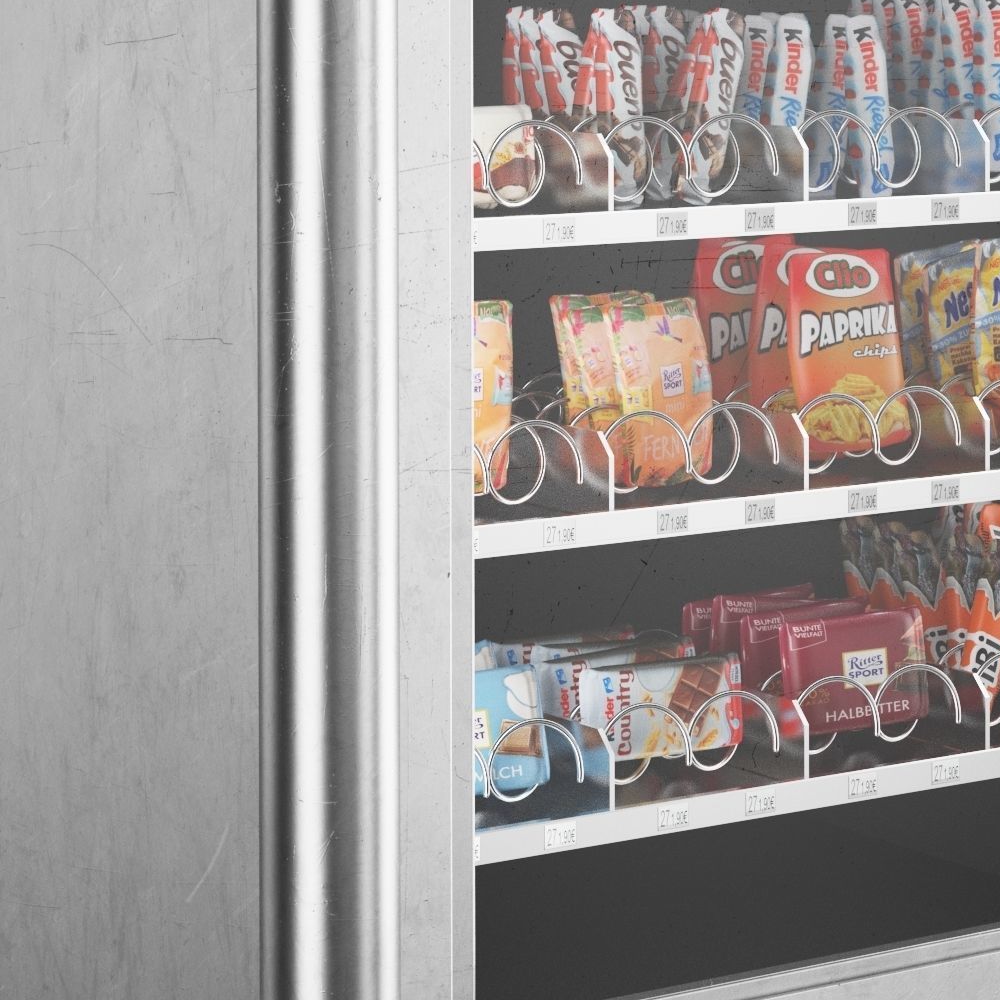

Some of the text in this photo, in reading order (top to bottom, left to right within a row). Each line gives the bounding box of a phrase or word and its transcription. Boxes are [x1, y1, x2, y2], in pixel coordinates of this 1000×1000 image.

[850, 206, 859, 223] 27
[934, 202, 942, 218] 27
[660, 217, 669, 234] 27
[748, 212, 756, 229] 27
[814, 259, 871, 290] Clio
[801, 304, 897, 356] PAPRIKA
[853, 344, 897, 358] chips
[663, 380, 682, 391] SPORT
[851, 493, 859, 509] 27
[748, 504, 757, 521] 27
[660, 514, 670, 530] 27
[547, 526, 556, 543] 27
[726, 600, 753, 609] BUNTE
[753, 617, 782, 626] BUNTE
[793, 623, 822, 633] BUNTE
[795, 630, 823, 639] VIELFALT
[848, 654, 883, 670] Ritter
[849, 667, 885, 679] SPORT
[851, 779, 860, 795] 27
[749, 795, 757, 812] 27
[661, 810, 670, 827] 27
